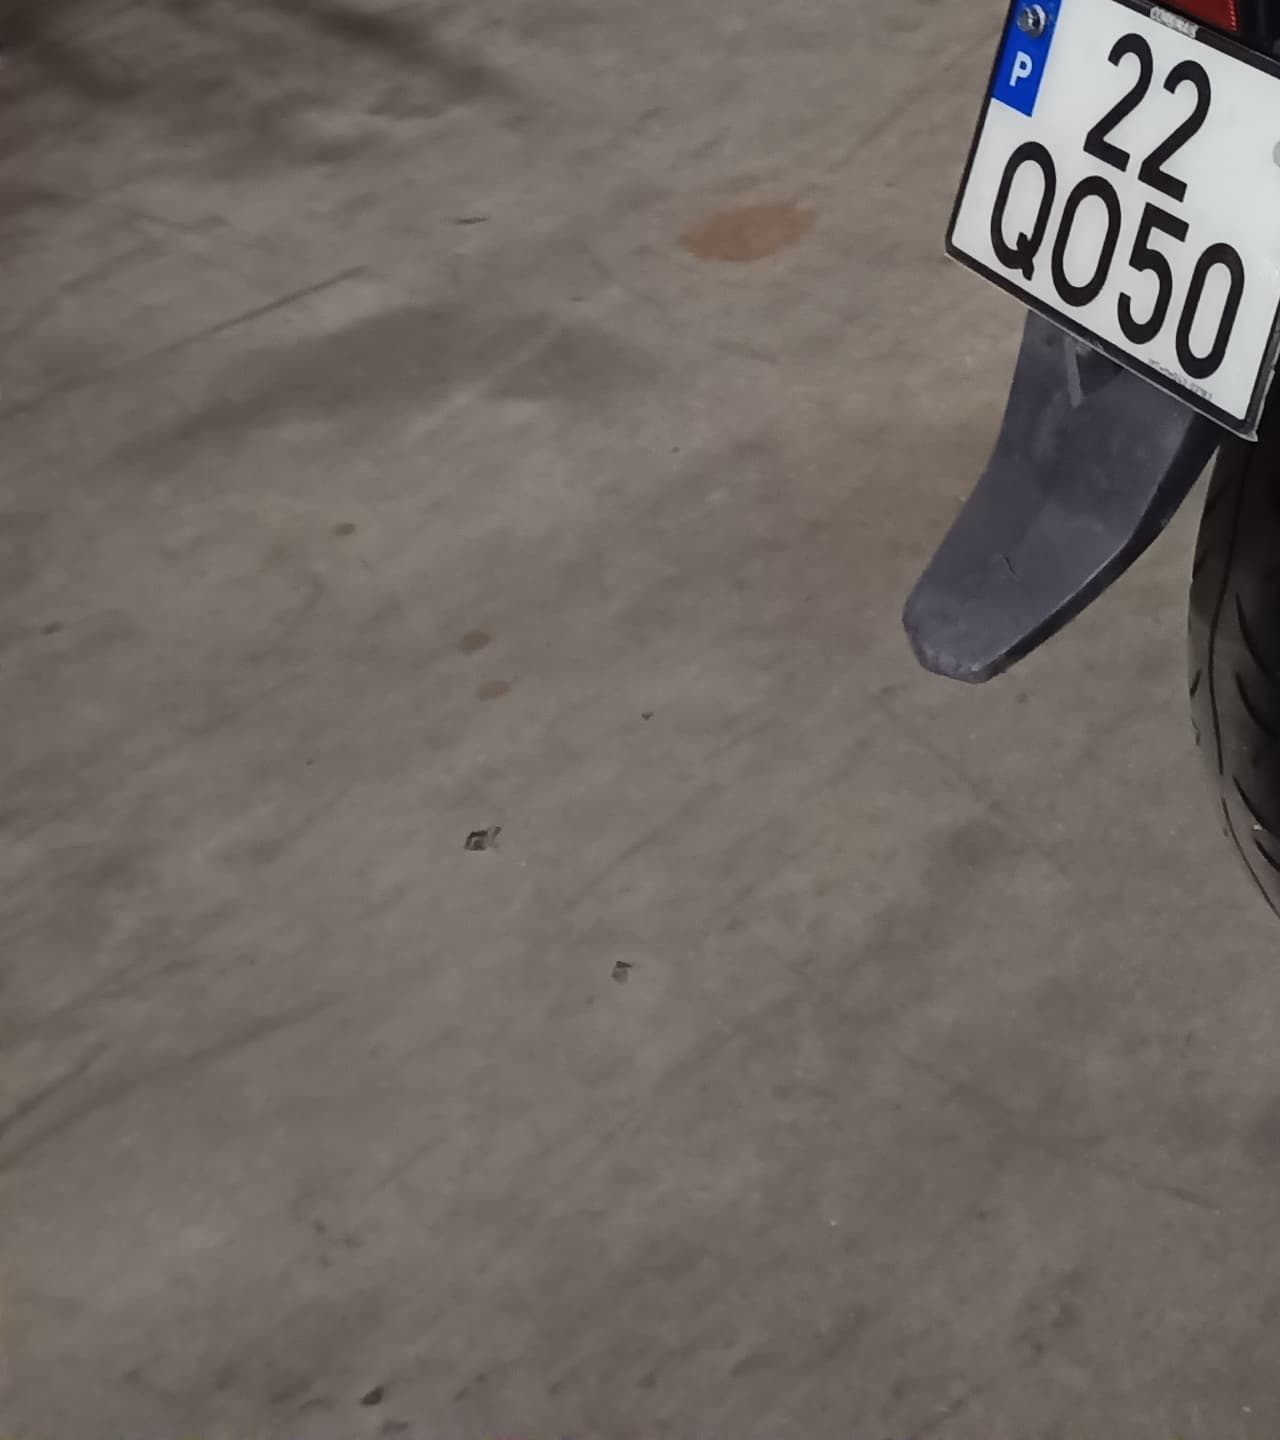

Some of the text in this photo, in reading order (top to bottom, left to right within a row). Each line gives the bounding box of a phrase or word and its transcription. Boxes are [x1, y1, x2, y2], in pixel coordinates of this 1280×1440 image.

[1009, 51, 1033, 86] P
[1083, 33, 1211, 202] 22
[990, 141, 1245, 379] QO50
